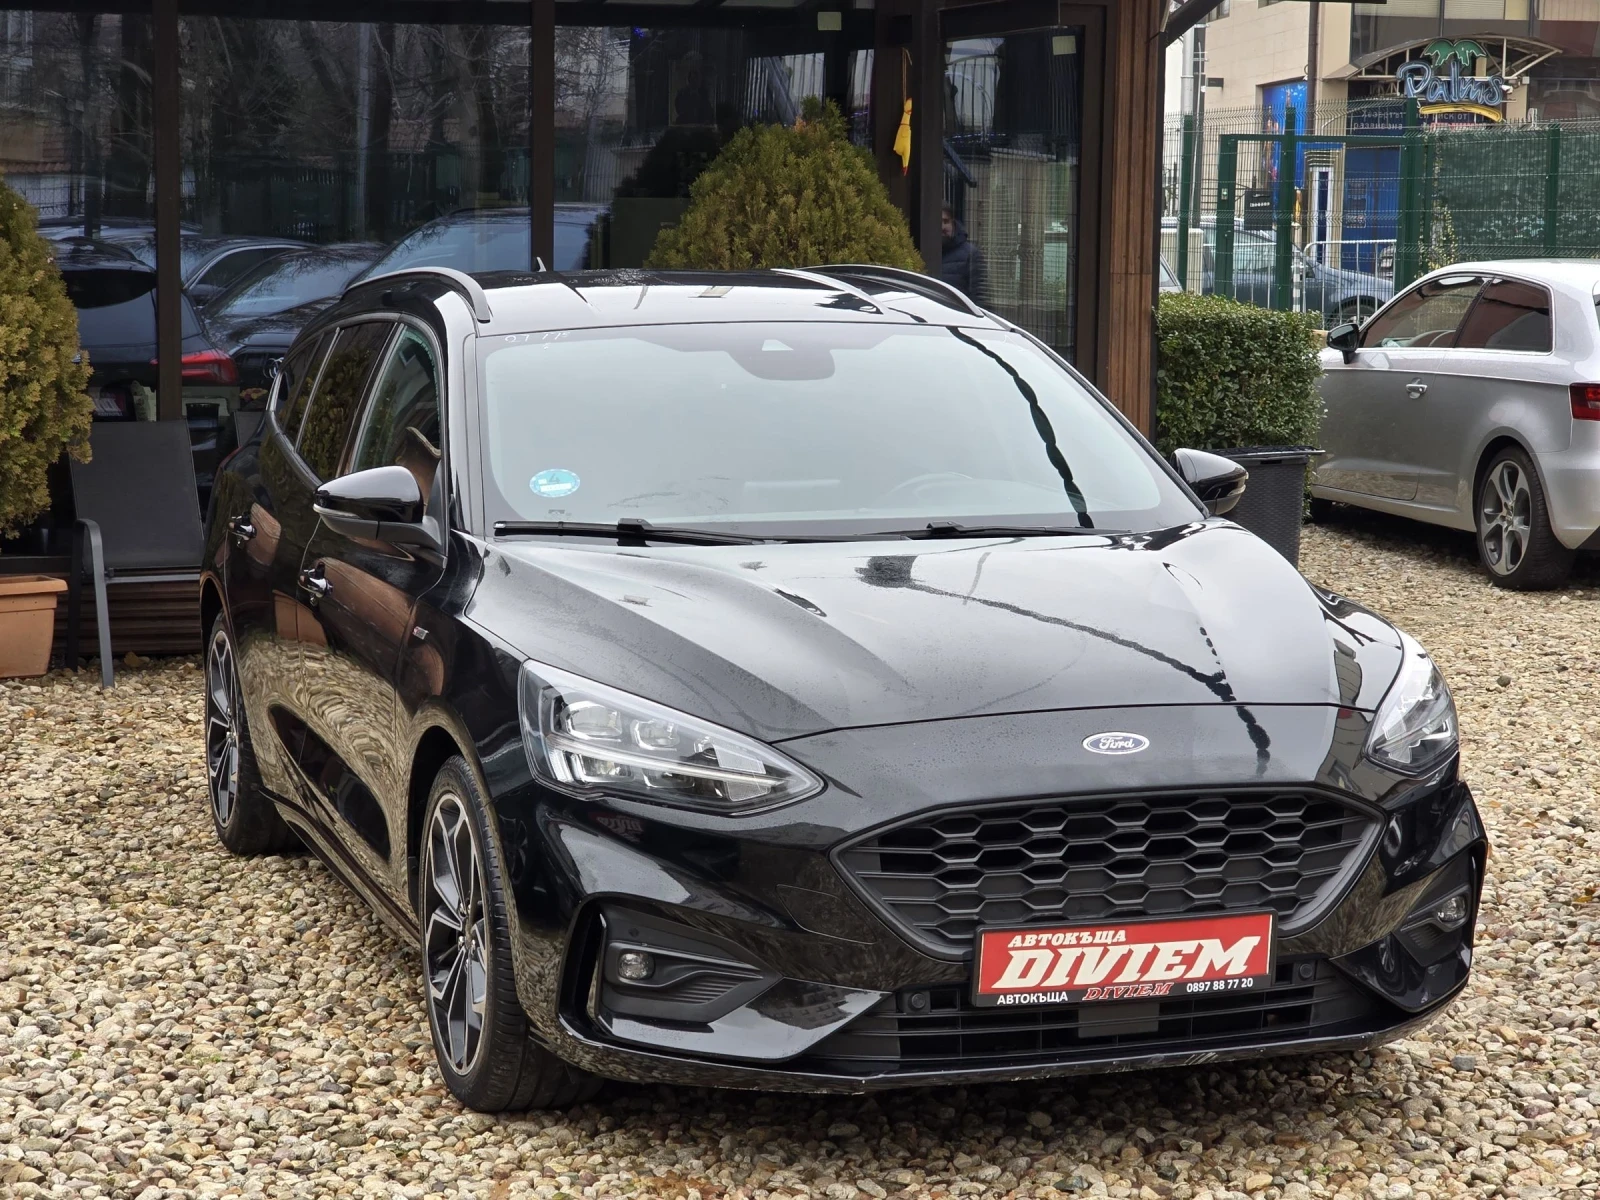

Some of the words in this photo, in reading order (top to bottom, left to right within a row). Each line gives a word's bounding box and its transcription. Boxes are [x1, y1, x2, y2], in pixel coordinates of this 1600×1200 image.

[1396, 60, 1504, 106] Palms
[1099, 736, 1135, 750] Ford
[1007, 929, 1126, 948] АВТОКЪЩА
[991, 936, 1261, 989] DIVIEM
[1082, 982, 1174, 1001] DIVIEM
[1186, 981, 1211, 993] 0897
[1212, 979, 1226, 991] 88
[1227, 978, 1240, 990] 77
[1240, 977, 1254, 989] 20
[997, 992, 1069, 1005] АВТОКЪЩА
